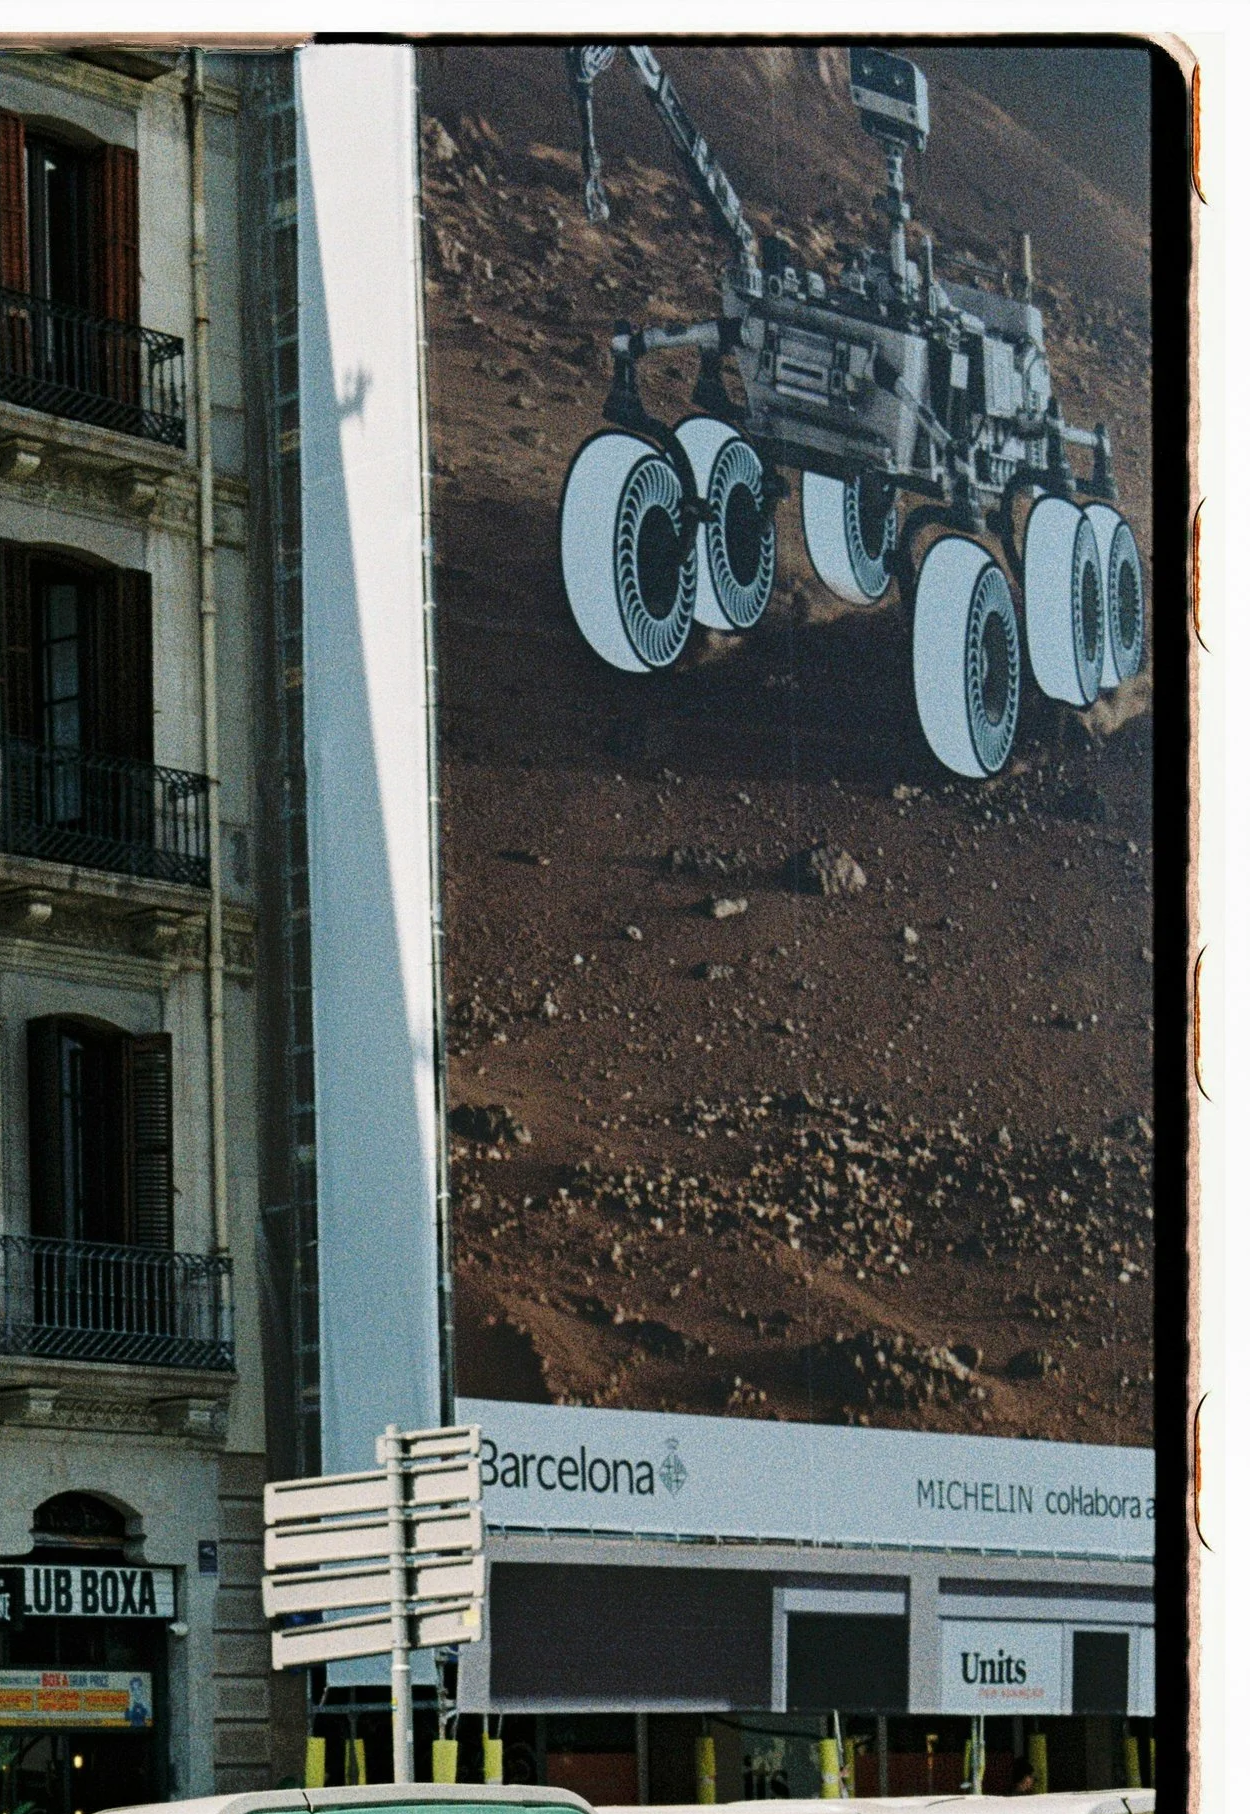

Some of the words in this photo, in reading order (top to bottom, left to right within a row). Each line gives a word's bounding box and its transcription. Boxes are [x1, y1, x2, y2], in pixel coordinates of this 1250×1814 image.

[480, 1438, 655, 1494] Barcelona
[917, 1479, 1033, 1513] MICHELIN
[80, 1569, 157, 1615] BOXA
[961, 1649, 1027, 1684] Units
